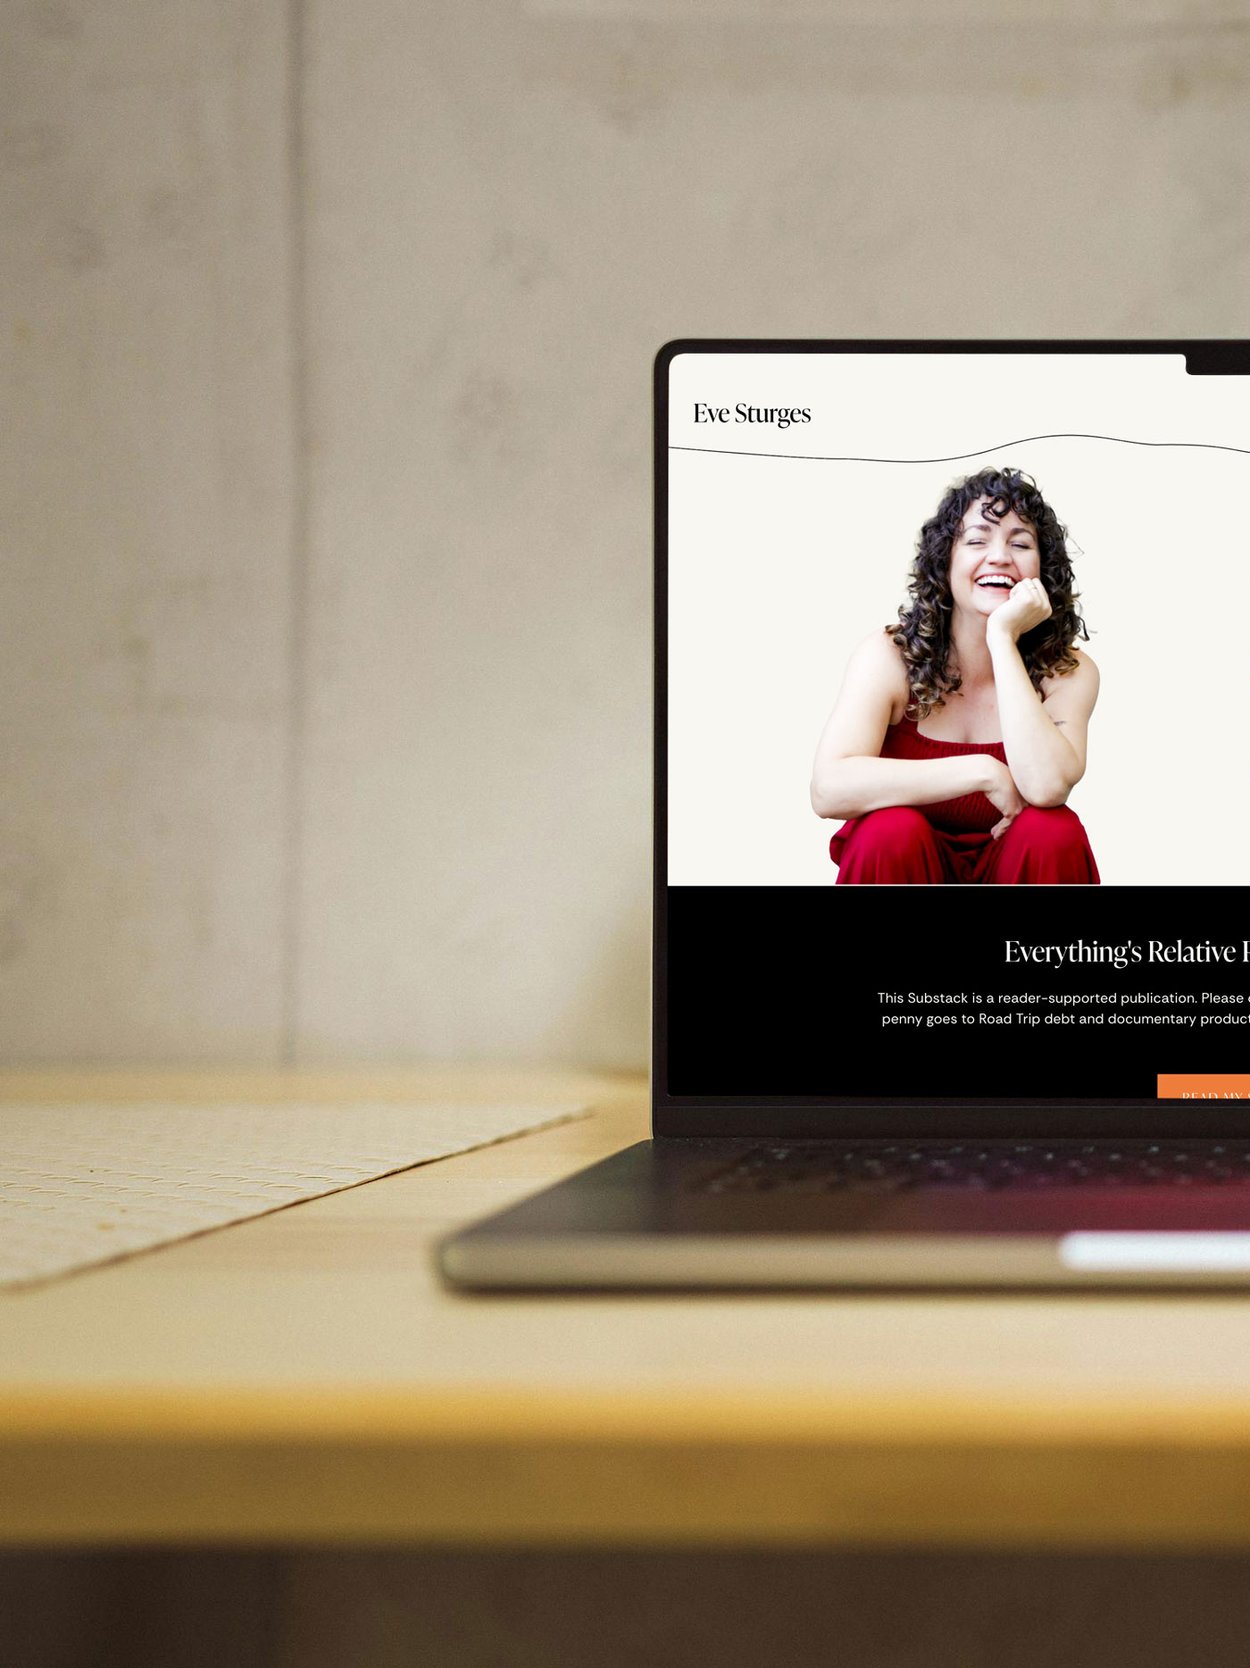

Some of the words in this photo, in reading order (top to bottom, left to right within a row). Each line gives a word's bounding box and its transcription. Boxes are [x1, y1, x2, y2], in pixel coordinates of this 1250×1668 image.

[694, 402, 731, 424] Eve
[734, 402, 812, 430] Sturges
[1005, 939, 1143, 970] Everything's
[1148, 939, 1237, 963] Relative
[877, 992, 904, 1004] This
[907, 992, 968, 1004] Substack
[972, 992, 983, 1004] is
[986, 994, 995, 1004] a
[998, 992, 1117, 1007] reader-supported
[1120, 992, 1198, 1007] publication.
[1201, 992, 1244, 1004] Please
[882, 1015, 923, 1028] penny
[926, 1015, 958, 1028] goes
[961, 1014, 975, 1025] to
[979, 1012, 1012, 1025] Road
[1015, 1012, 1041, 1027] Trip
[1044, 1012, 1075, 1025] debt
[1078, 1013, 1104, 1025] and
[1107, 1013, 1197, 1028] documentary
